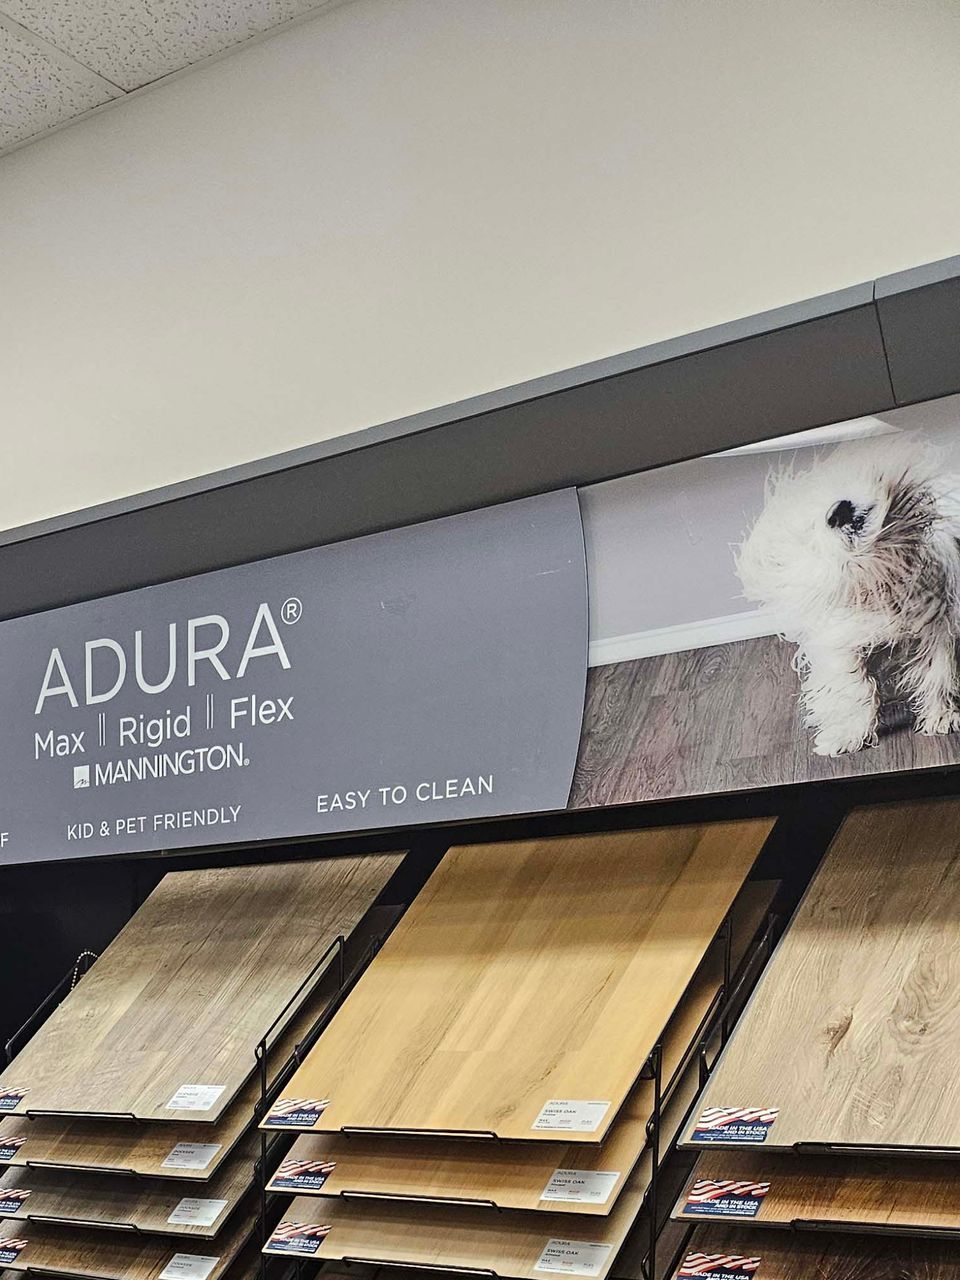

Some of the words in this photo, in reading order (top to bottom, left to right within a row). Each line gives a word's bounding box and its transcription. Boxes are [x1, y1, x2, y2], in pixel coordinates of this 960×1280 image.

[34, 730, 86, 760] Max
[119, 705, 191, 748] Rigid
[230, 694, 294, 729] Flex
[317, 790, 371, 813] EASY
[379, 785, 407, 805] TO
[416, 775, 493, 801] CLEAN
[67, 823, 93, 841] KID
[99, 821, 110, 837] &
[115, 816, 147, 834] PET
[153, 805, 241, 831] FRIENDLY
